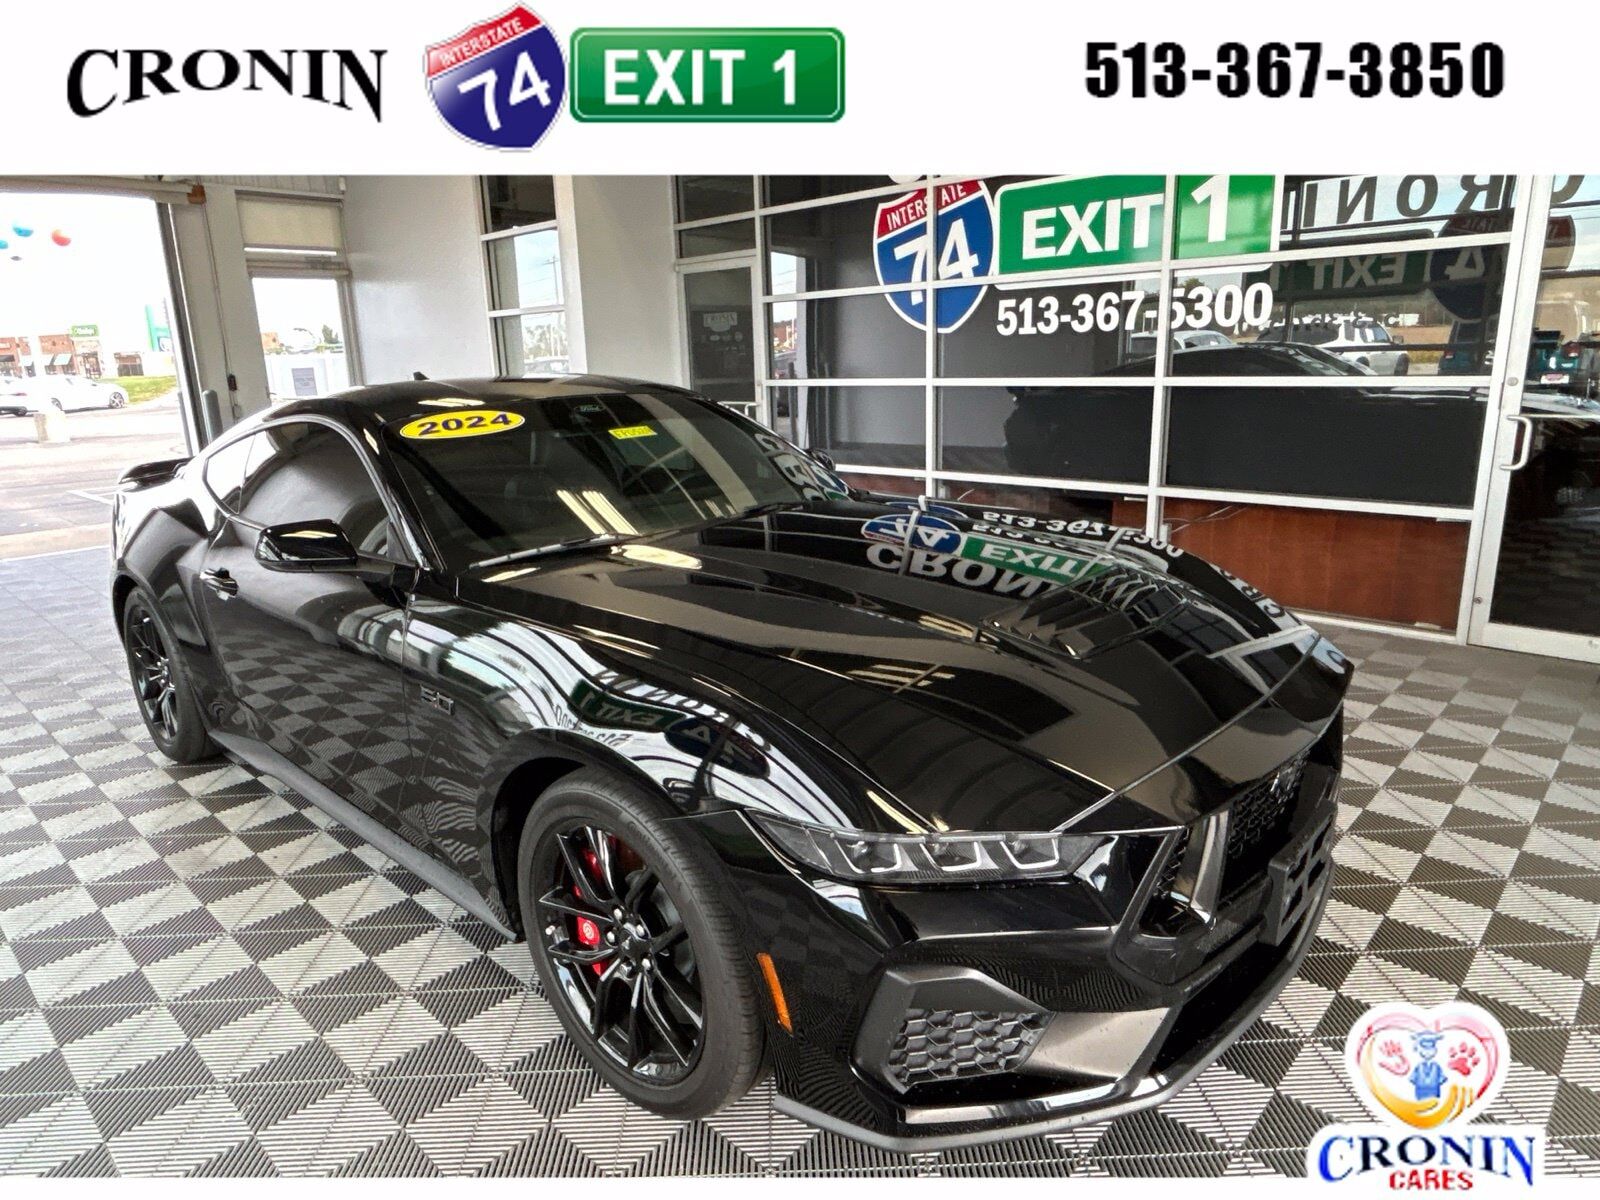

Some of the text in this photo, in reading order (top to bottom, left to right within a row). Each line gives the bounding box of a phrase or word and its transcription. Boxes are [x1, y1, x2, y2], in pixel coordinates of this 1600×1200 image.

[886, 184, 968, 232] INTERSATE
[1022, 175, 1231, 260] EXIT 1
[894, 218, 980, 307] 74
[996, 282, 1274, 337] 513-367-5300
[417, 412, 512, 437] 2024
